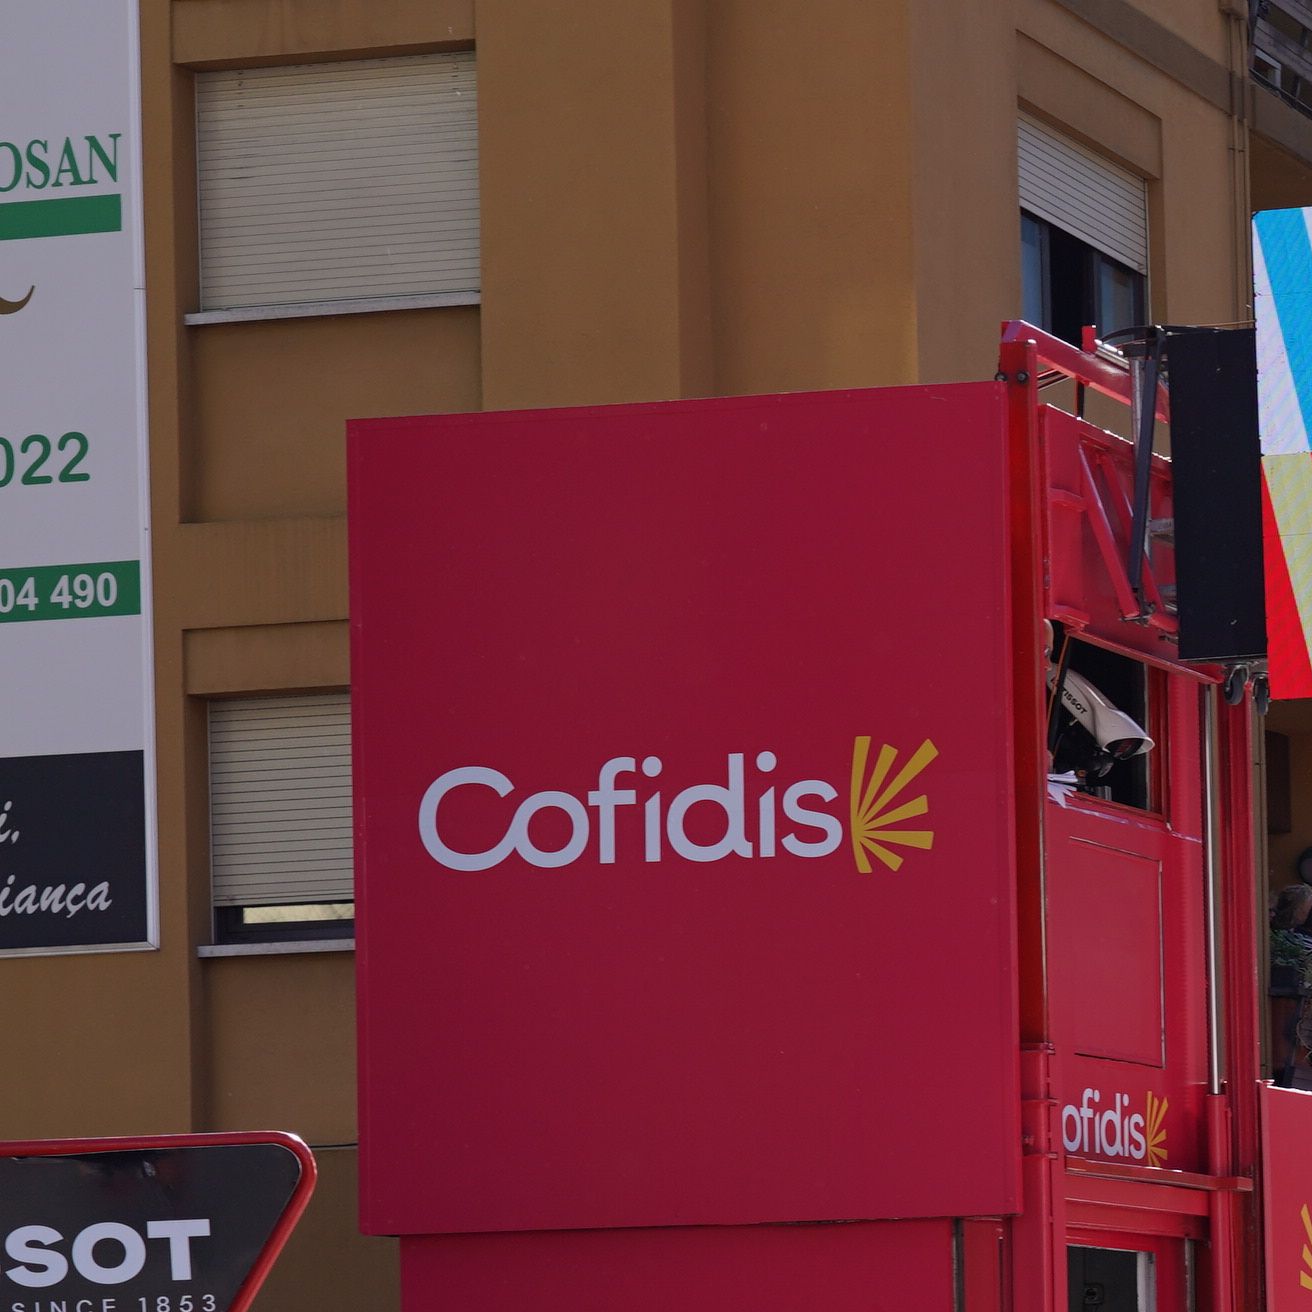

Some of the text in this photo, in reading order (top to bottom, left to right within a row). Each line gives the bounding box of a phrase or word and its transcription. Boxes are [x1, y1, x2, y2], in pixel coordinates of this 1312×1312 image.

[50, 572, 118, 609] 490
[419, 750, 843, 872] Cofidis
[1062, 1087, 1146, 1160] ofidis
[4, 1218, 211, 1288] SOT
